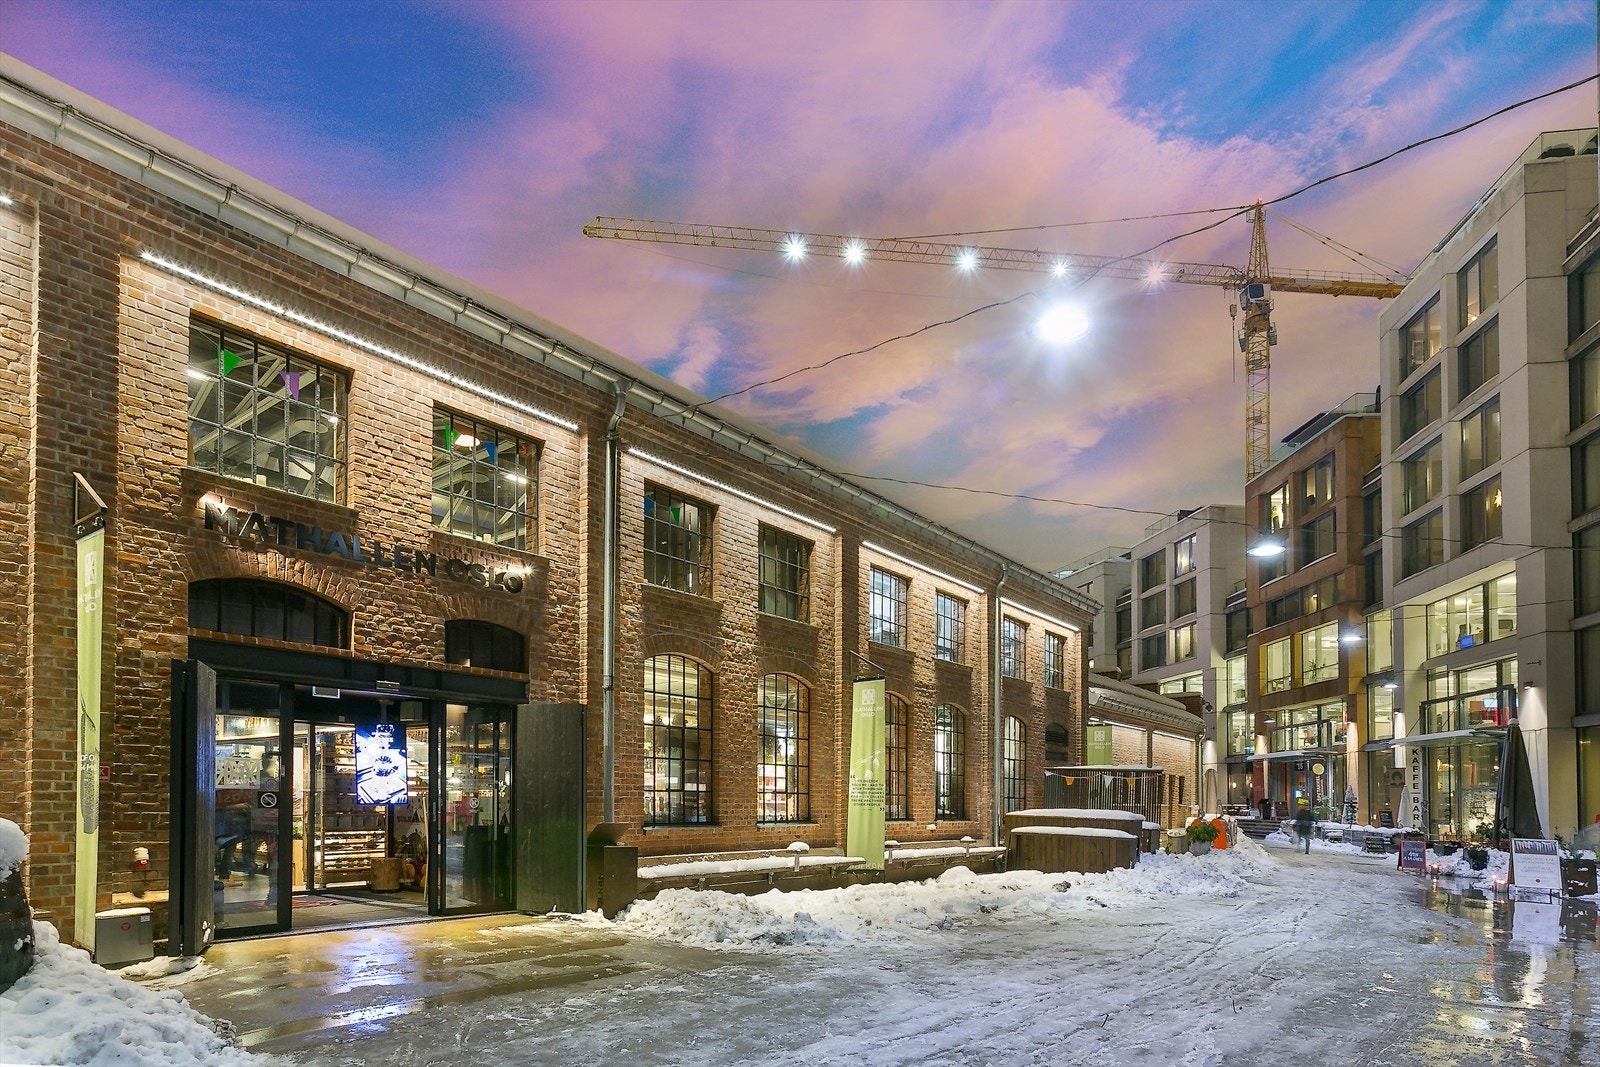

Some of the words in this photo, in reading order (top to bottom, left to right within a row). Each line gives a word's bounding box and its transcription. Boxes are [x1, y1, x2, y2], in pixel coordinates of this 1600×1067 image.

[204, 501, 437, 577] MATHALLEN
[448, 558, 524, 594] OSLO
[1411, 748, 1420, 790] KAFFE
[1412, 796, 1420, 821] BAR
